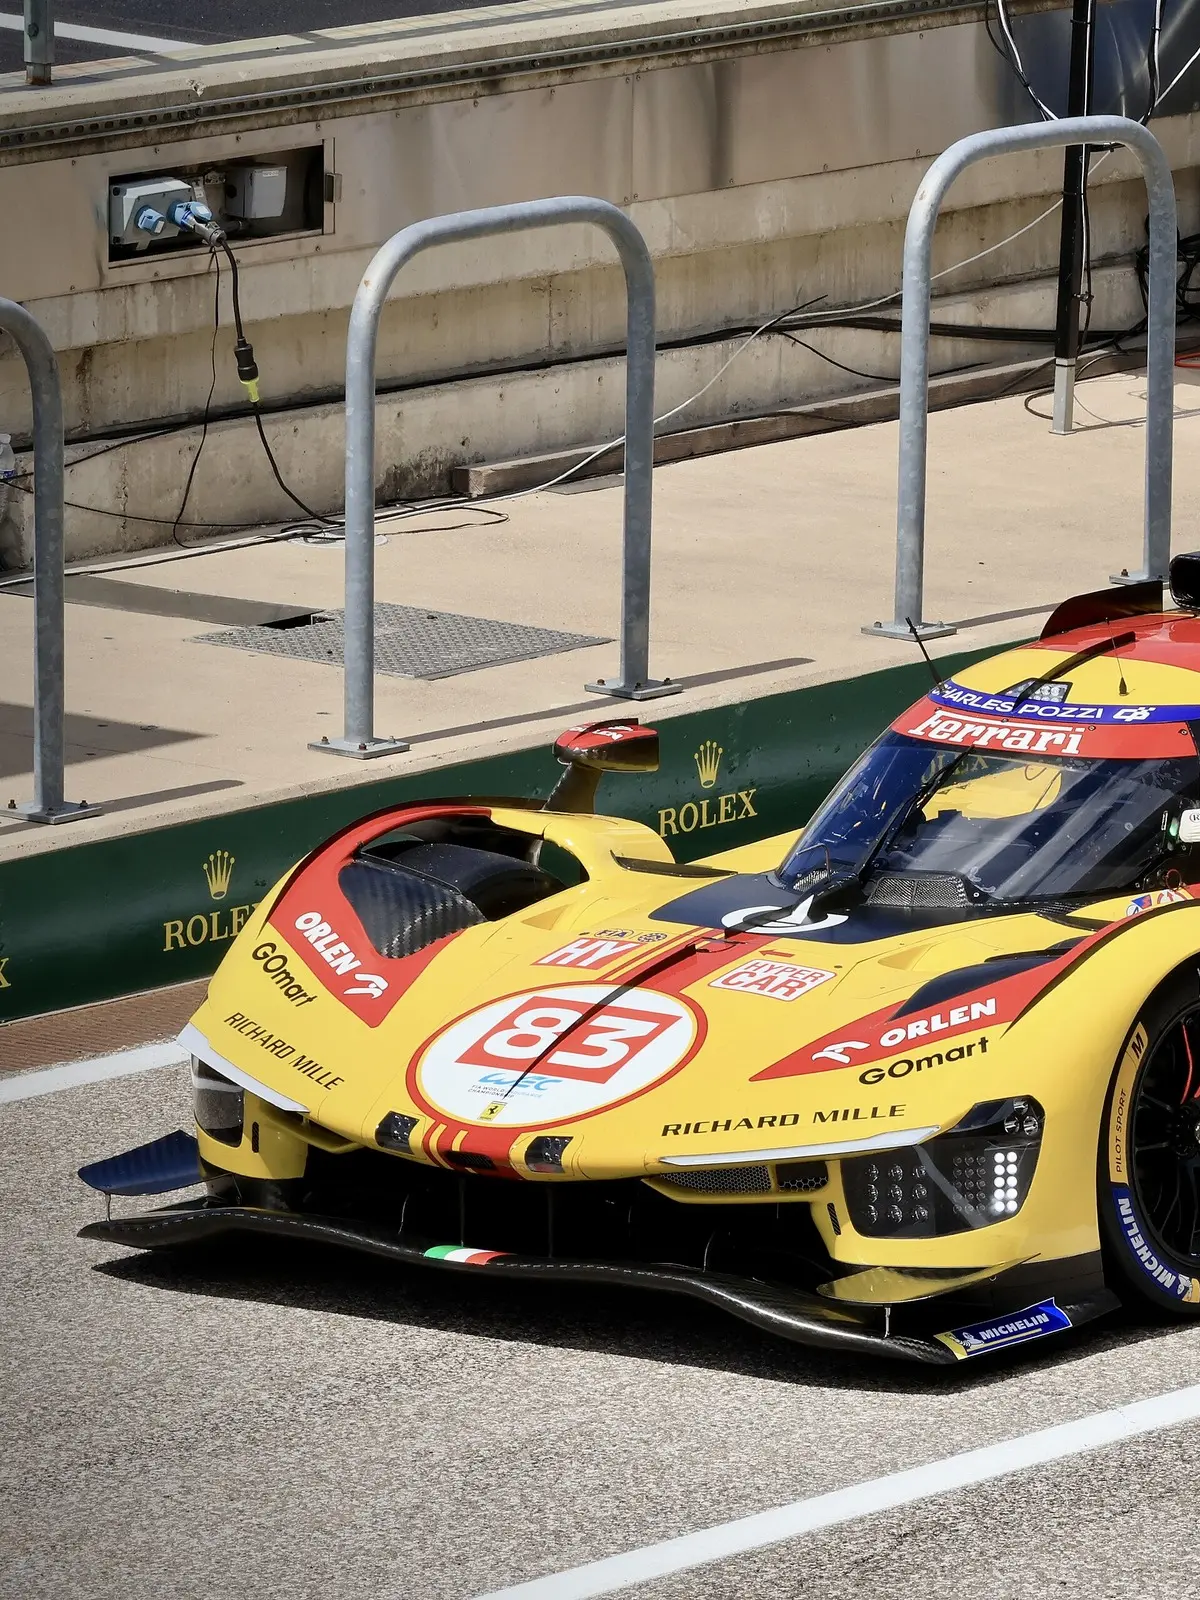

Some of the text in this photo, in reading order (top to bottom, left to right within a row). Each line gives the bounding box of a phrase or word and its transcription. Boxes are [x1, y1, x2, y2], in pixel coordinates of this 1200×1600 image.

[931, 683, 1103, 719] CHARLES POZZI
[908, 708, 1086, 755] Ferrari
[657, 788, 758, 838] ROLEX
[163, 902, 259, 952] ROLE
[294, 911, 361, 976] ORLEN
[251, 942, 318, 1008] GOmart
[533, 938, 641, 967] HY
[743, 961, 828, 982] HYPER
[720, 971, 806, 999] CAR
[483, 1007, 661, 1069] 83
[879, 998, 997, 1047] ORLEN
[1131, 1031, 1145, 1060] M
[223, 1012, 345, 1091] RICHARD MILLE
[859, 1036, 989, 1085] GOmart
[660, 1103, 907, 1137] RICHARD MILLE
[1115, 1088, 1127, 1173] PILOT SPORT
[1118, 1197, 1172, 1289] MICHELIN
[978, 1312, 1050, 1341] MICHELIN
